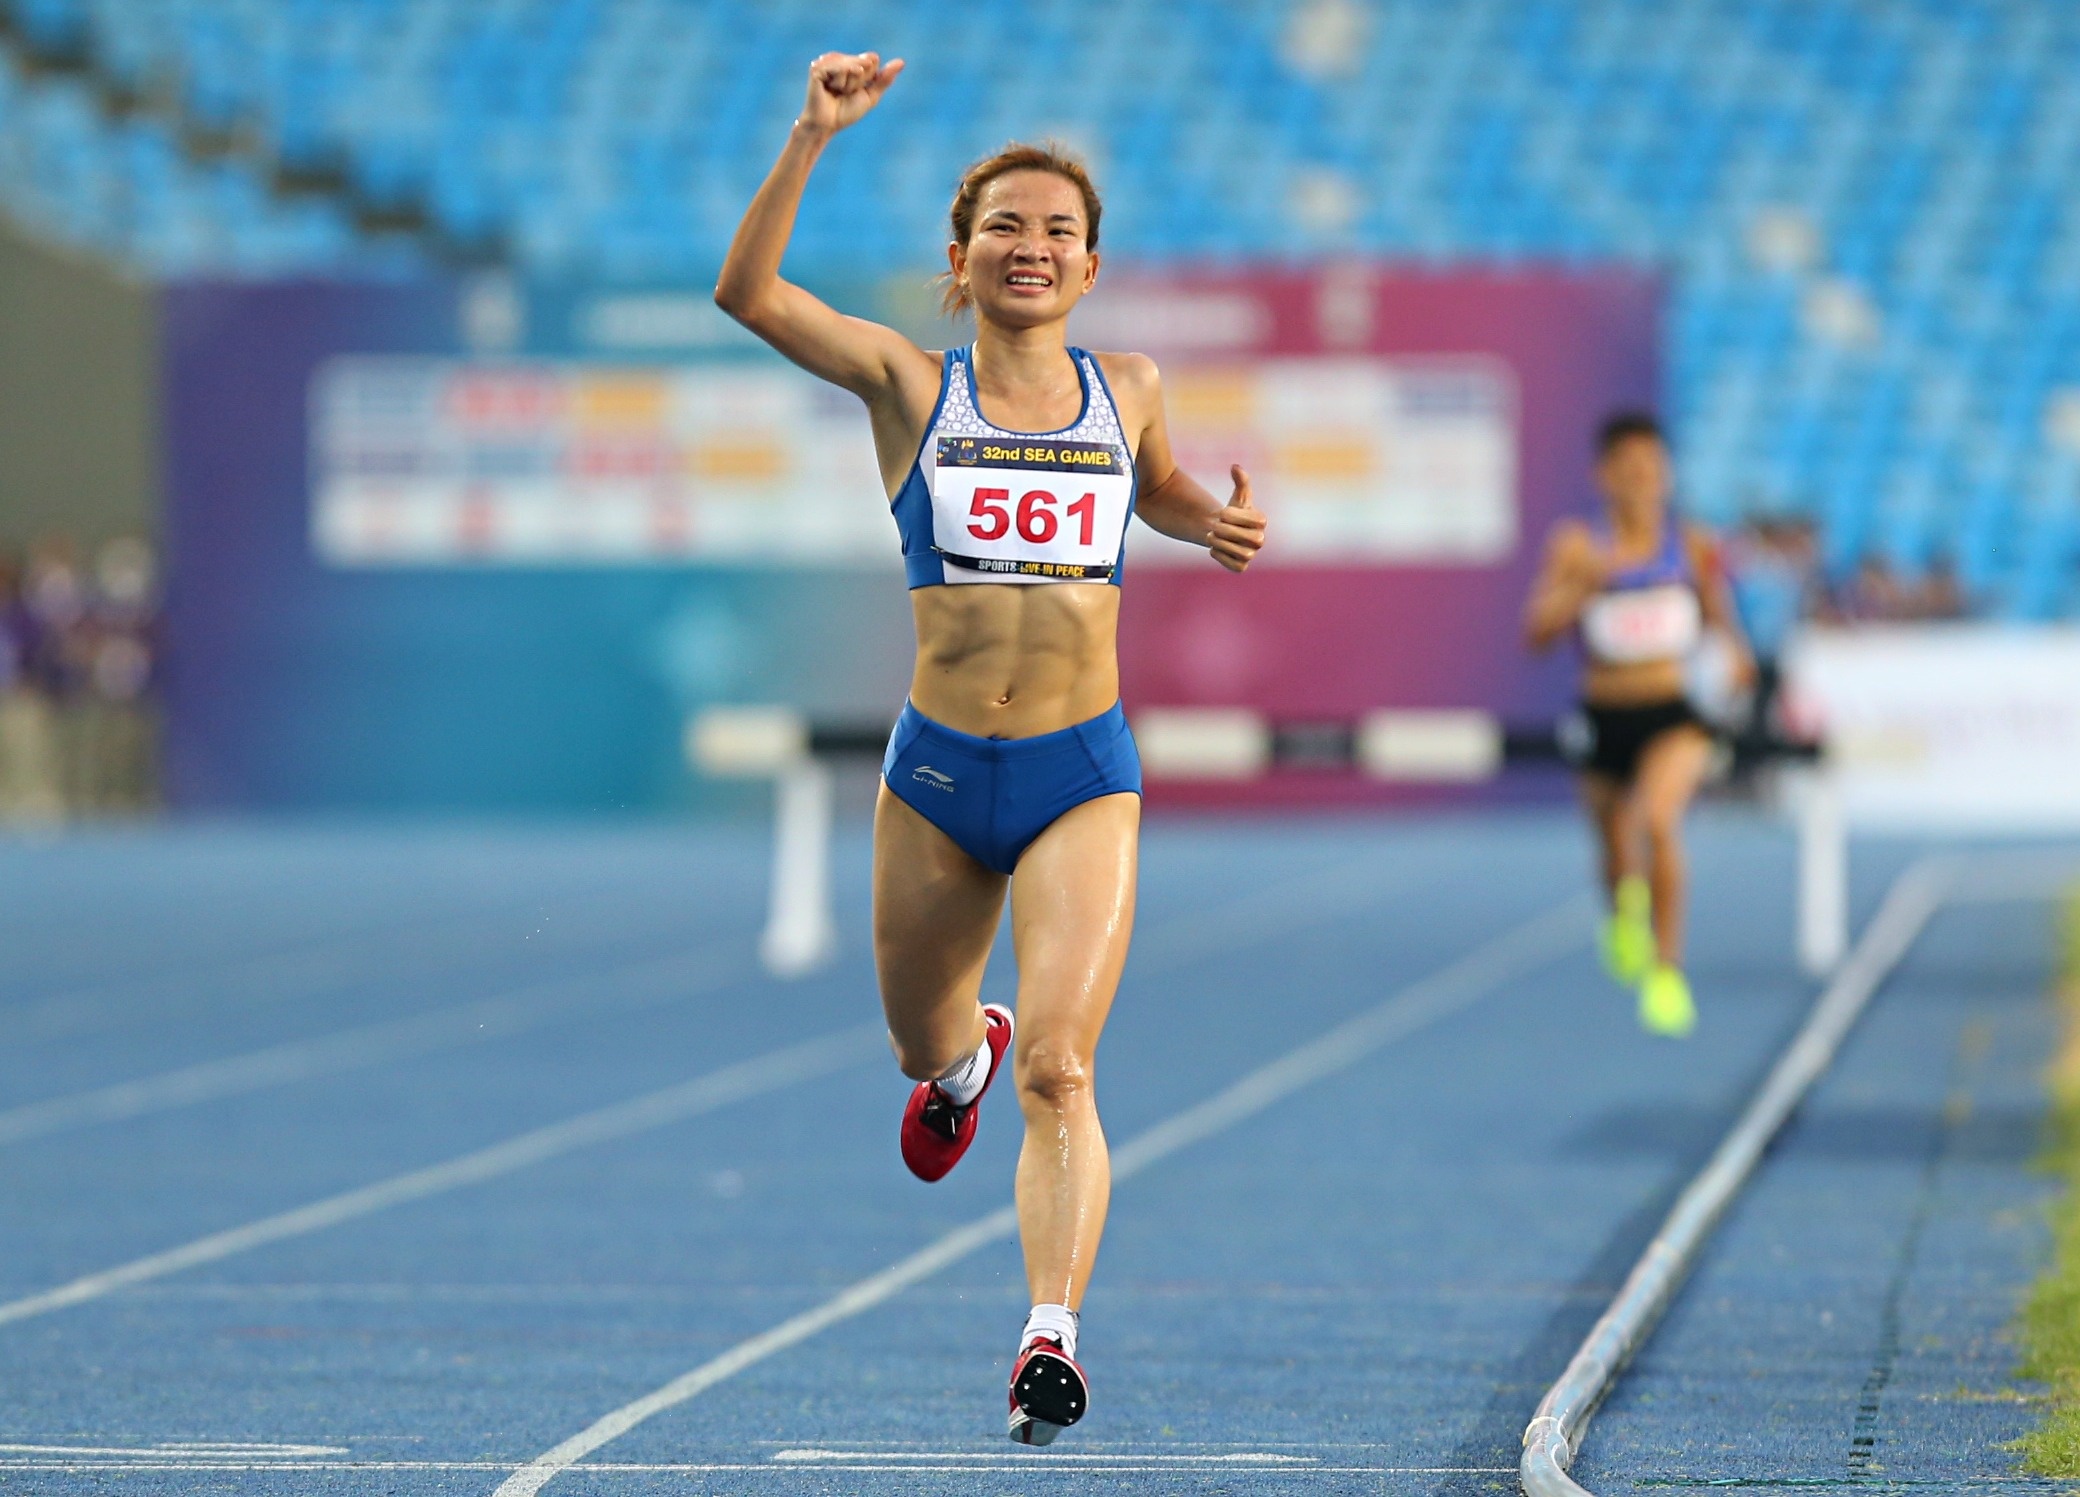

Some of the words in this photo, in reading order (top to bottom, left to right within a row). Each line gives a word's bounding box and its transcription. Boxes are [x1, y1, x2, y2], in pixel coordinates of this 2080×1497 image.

[983, 447, 1020, 461] 32nd
[1024, 448, 1056, 463] SEA
[1060, 451, 1112, 466] GAMES
[966, 487, 1096, 546] 561
[1043, 564, 1054, 574] IN
[1056, 565, 1085, 577] PEACE
